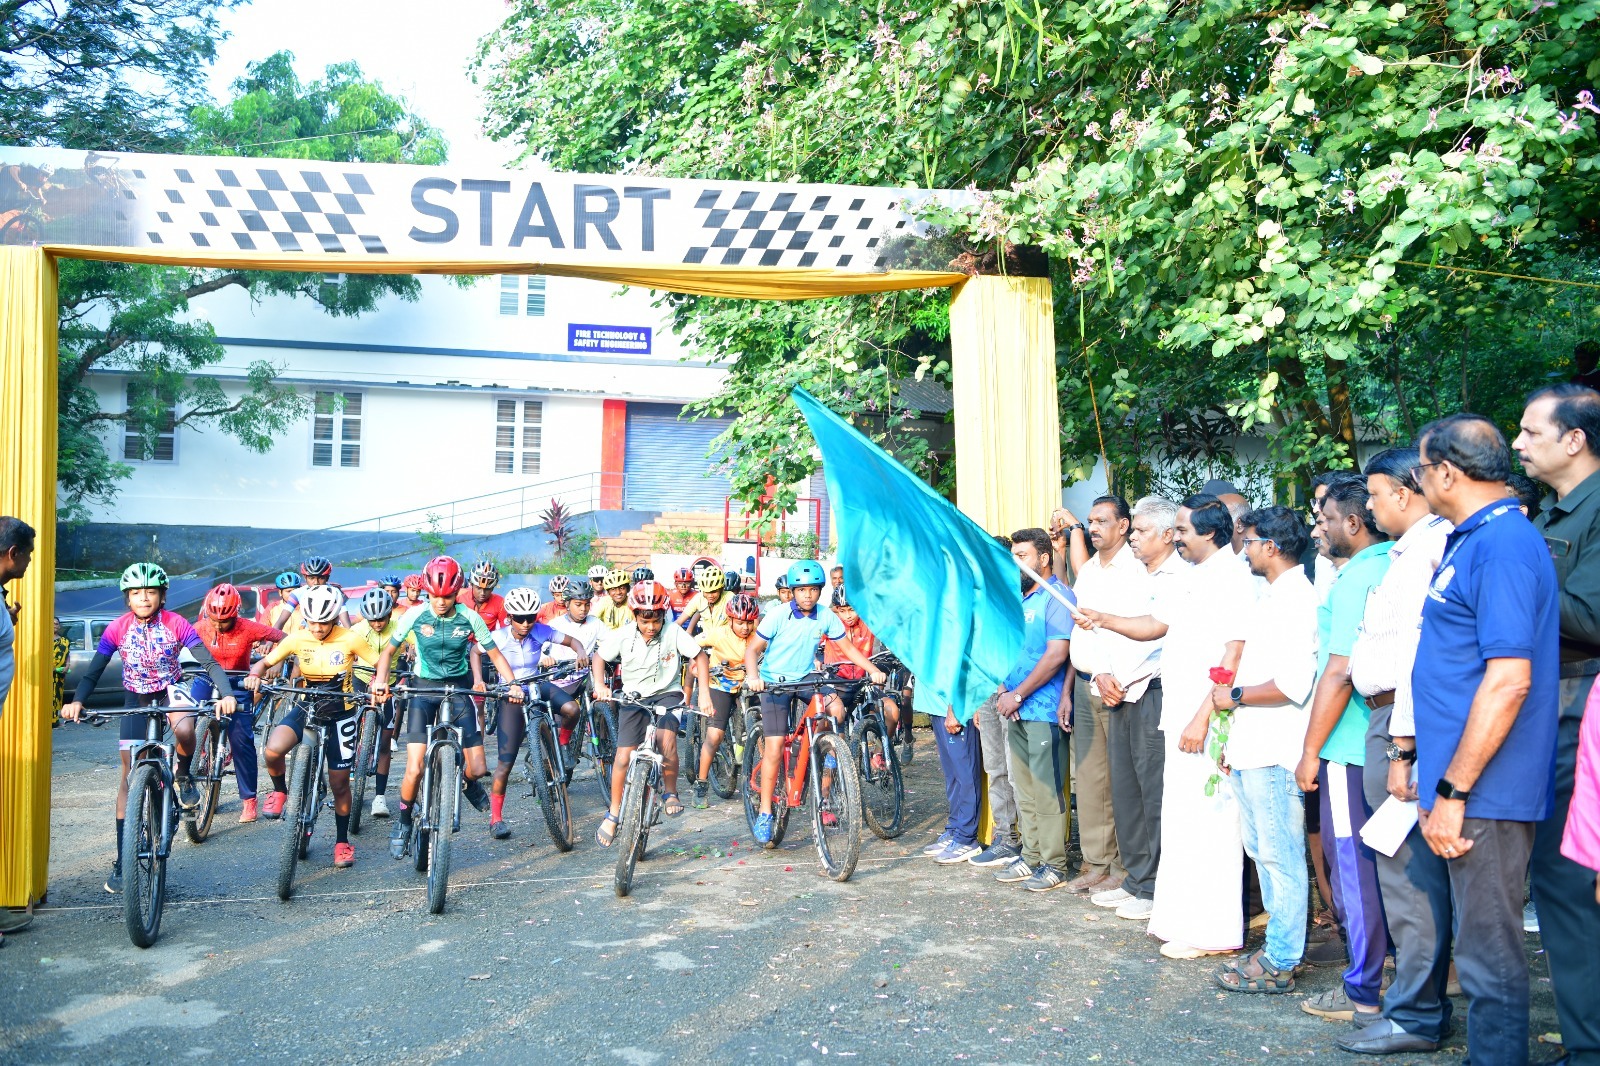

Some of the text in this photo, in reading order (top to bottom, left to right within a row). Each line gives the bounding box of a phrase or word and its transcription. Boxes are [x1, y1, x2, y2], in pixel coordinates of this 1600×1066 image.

[408, 176, 671, 252] START
[575, 330, 646, 340] FIRE TECHNOLOGY &
[573, 339, 648, 349] SAFETY ENGINEERING
